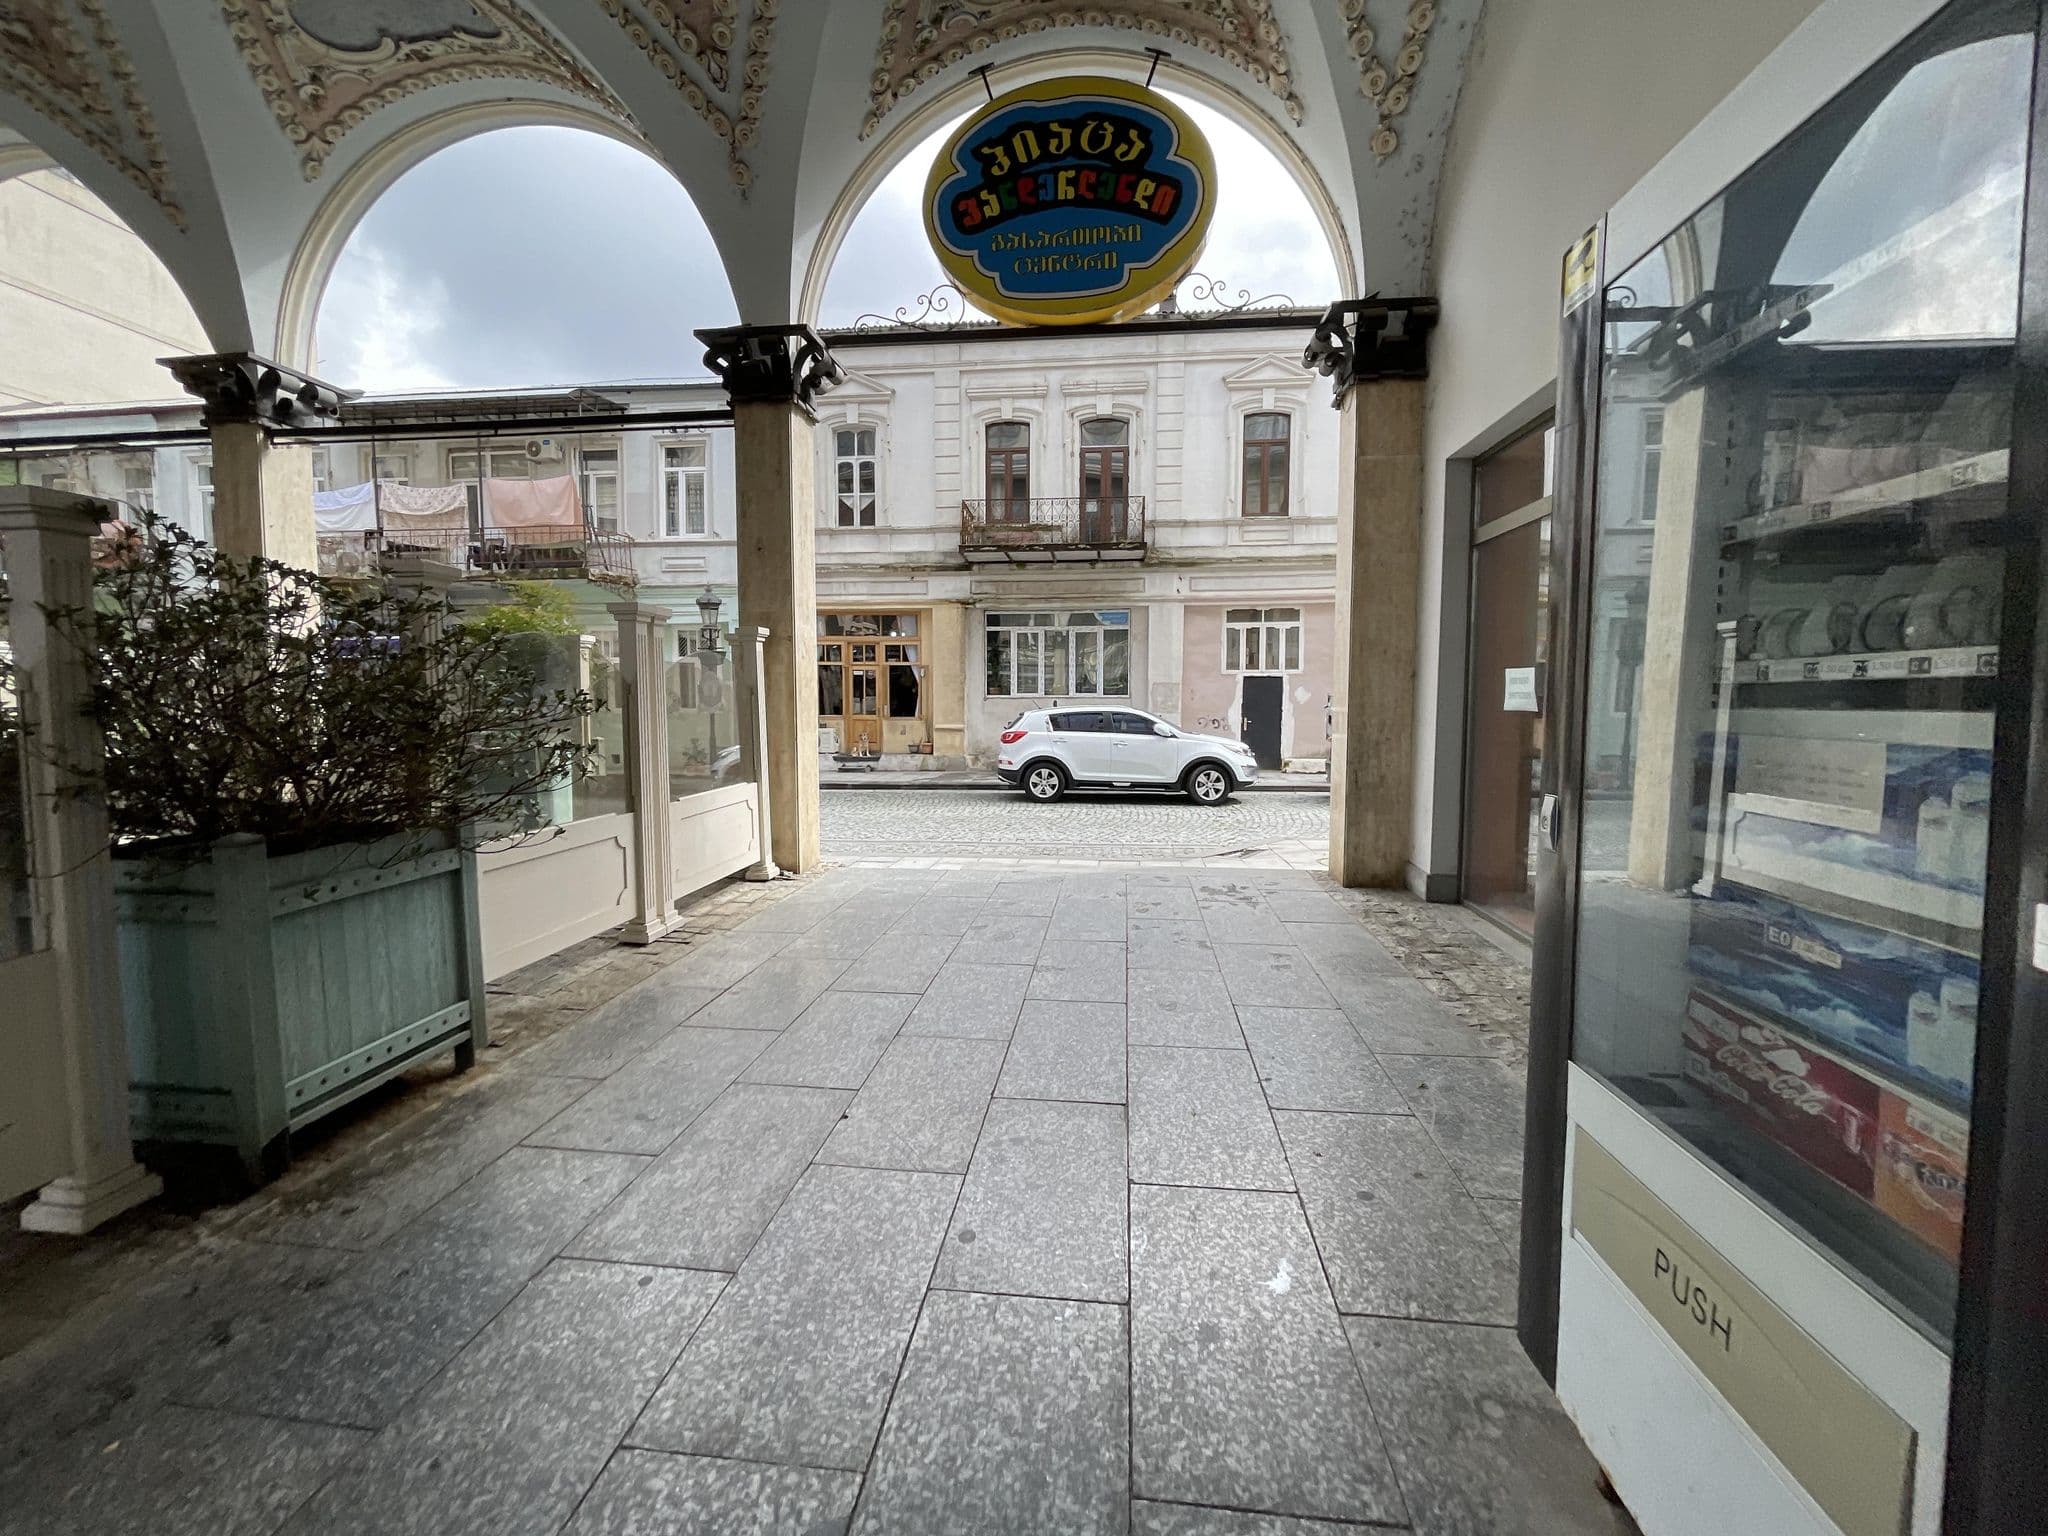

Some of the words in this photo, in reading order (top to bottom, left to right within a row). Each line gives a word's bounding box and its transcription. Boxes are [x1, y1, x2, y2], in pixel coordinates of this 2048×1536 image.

[981, 119, 1146, 177] პიაცა
[991, 223, 1142, 253] გასართობი
[1014, 251, 1119, 275] ცენტრი
[1654, 1247, 1732, 1352] PUSH
